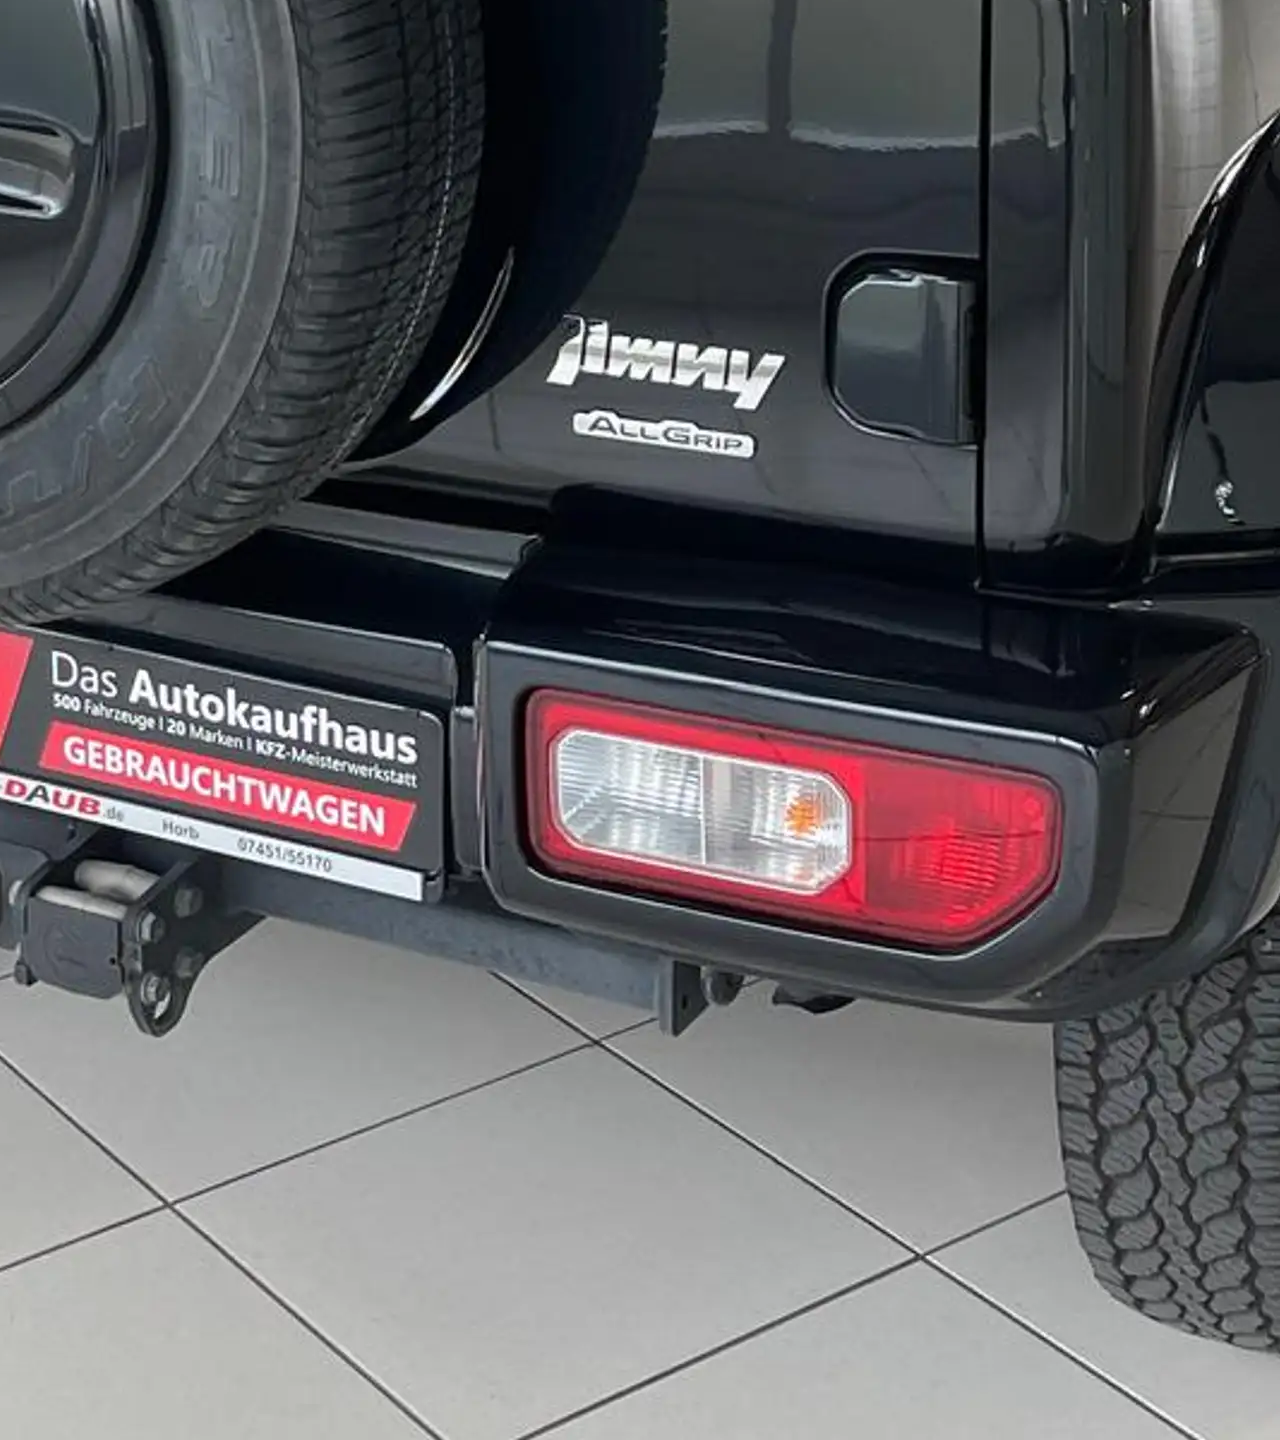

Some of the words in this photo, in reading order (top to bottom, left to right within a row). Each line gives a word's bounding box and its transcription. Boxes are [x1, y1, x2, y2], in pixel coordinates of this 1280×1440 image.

[50, 650, 119, 698] Das
[128, 668, 419, 765] Autokaufhaus
[52, 693, 82, 714] 500
[83, 696, 156, 731] Fahrzeuge
[166, 720, 186, 737] 20
[188, 725, 245, 751] Marken
[255, 738, 419, 788] KFZ-Meisterwerkstatt
[62, 734, 386, 836] GEBRAUCHTWAGEN
[160, 819, 201, 842] Horb
[236, 837, 333, 874] 07451/55170
